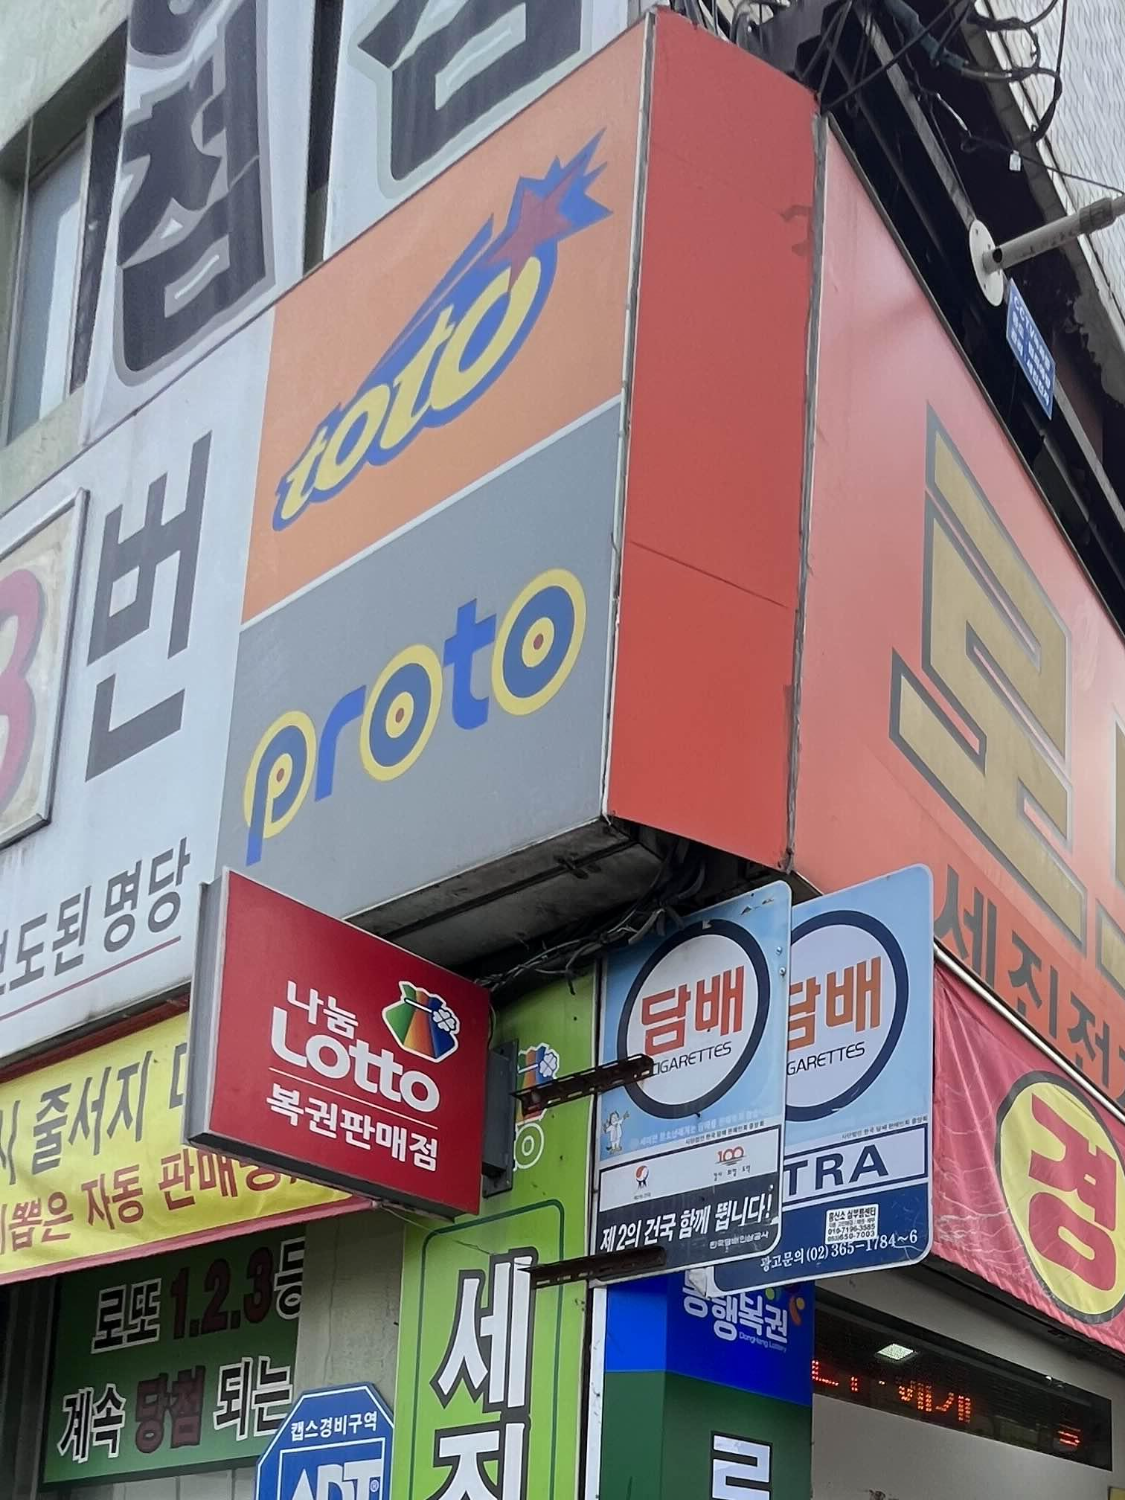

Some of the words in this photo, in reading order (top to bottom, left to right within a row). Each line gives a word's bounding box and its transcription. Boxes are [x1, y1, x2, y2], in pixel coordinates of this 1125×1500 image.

[273, 256, 557, 531] toto
[243, 568, 587, 866] proto
[104, 837, 191, 952] 명당
[288, 981, 358, 1039] 나눔
[641, 965, 745, 1056] 담배
[271, 1006, 440, 1112] Lotto
[787, 1041, 865, 1076] GARETTES
[32, 1050, 153, 1175] 줄서지
[266, 1083, 438, 1172] 복권판매점
[82, 1164, 144, 1230] 자동
[600, 1220, 642, 1252] 제2의
[643, 1213, 676, 1246] 건국
[679, 1205, 711, 1239] 함께
[1029, 1093, 1117, 1291] 경
[760, 1252, 804, 1272] 광고문의
[91, 1278, 162, 1354] 로또
[57, 1384, 126, 1464] 계속
[136, 1366, 206, 1453] 당첨
[213, 1356, 294, 1442] 되는
[291, 1411, 377, 1441] 캡스경비구역
